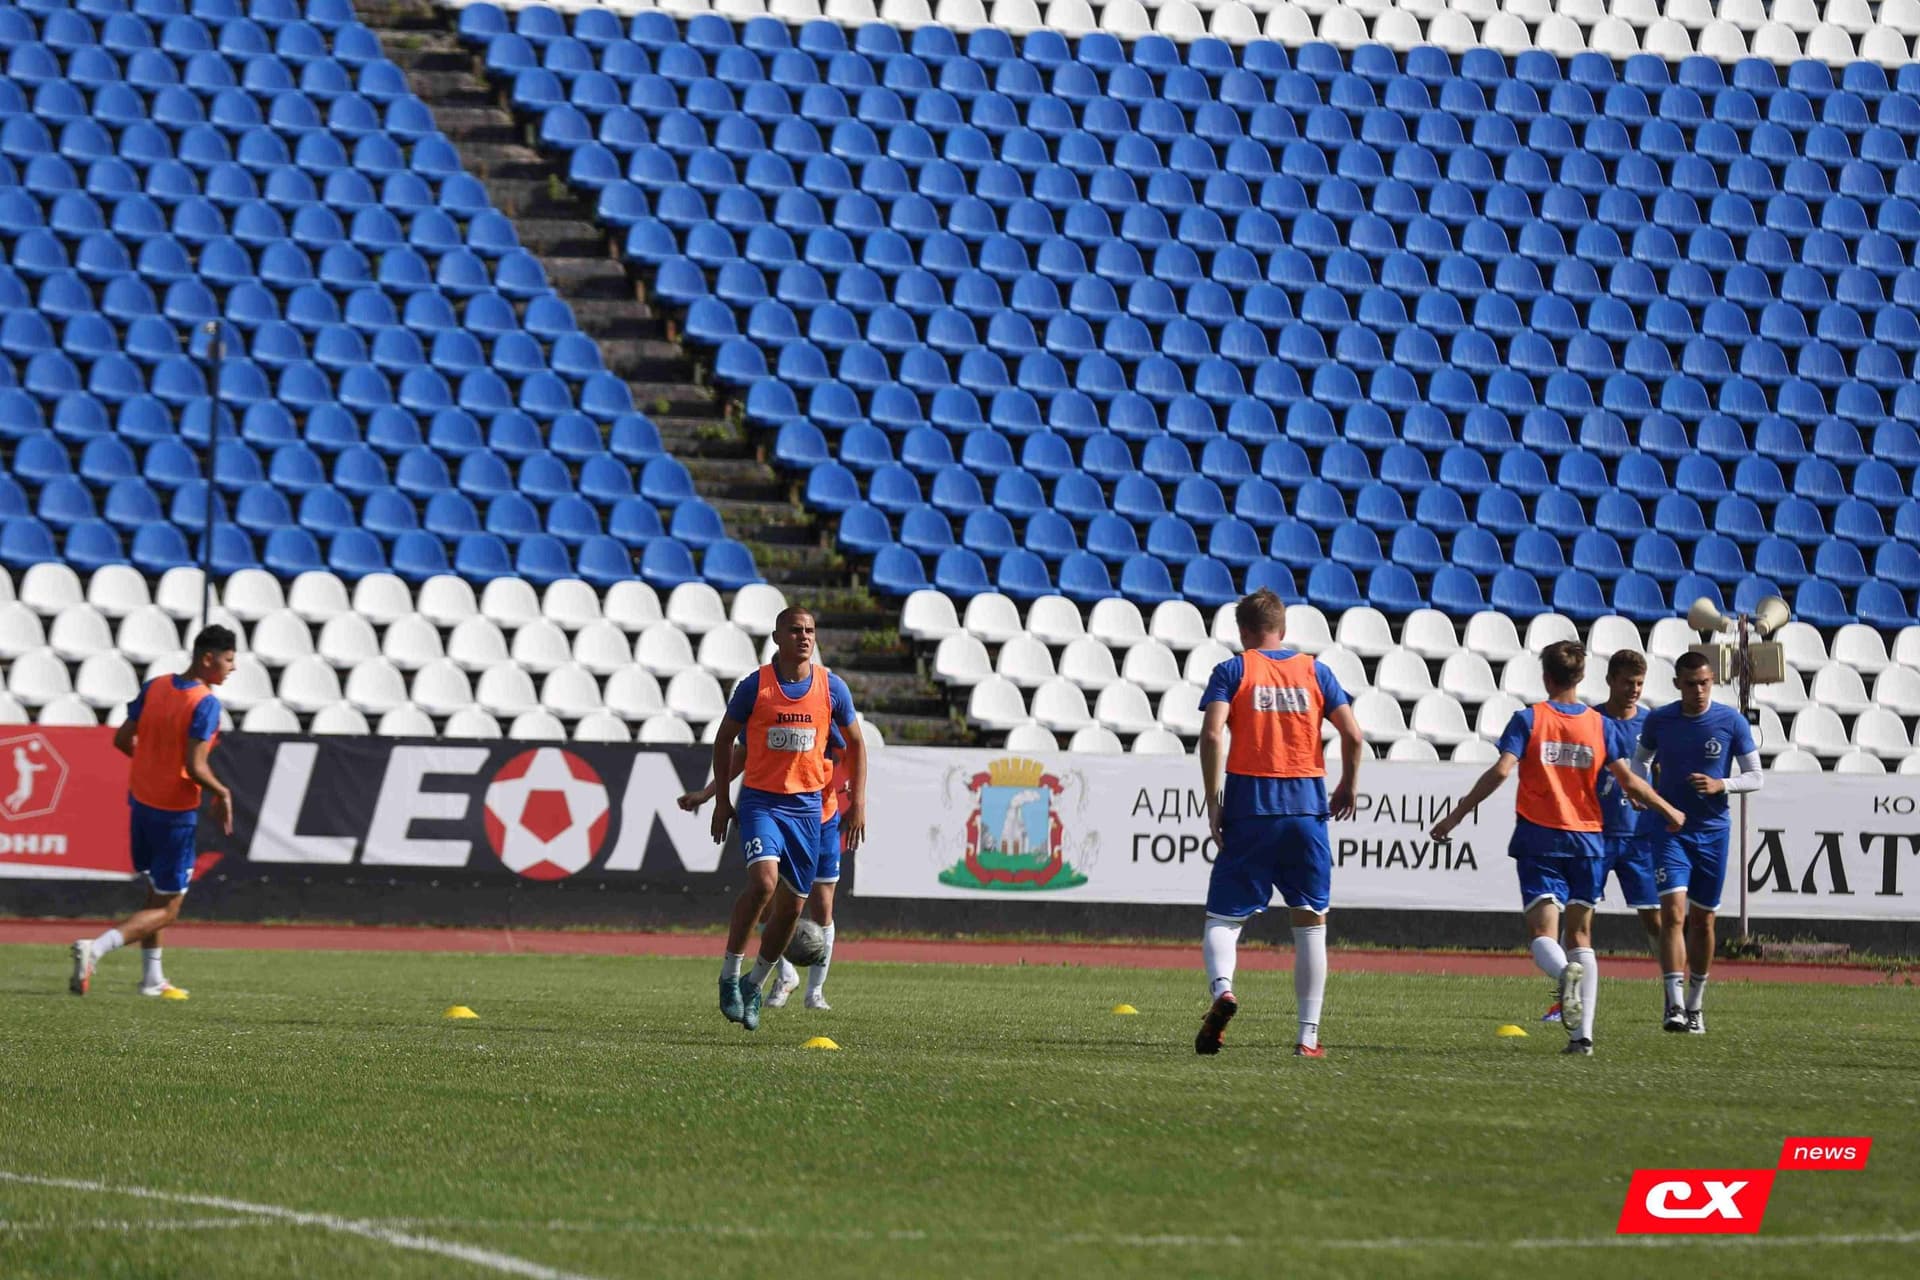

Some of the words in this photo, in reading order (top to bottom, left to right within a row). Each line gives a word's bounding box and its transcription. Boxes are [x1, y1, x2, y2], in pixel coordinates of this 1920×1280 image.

[776, 711, 813, 724] Joma
[1131, 786, 1479, 832] АДМРАЦИ
[744, 837, 763, 860] 23
[1132, 833, 1221, 864] ГОРО
[1331, 839, 1479, 871] РНАУЛА
